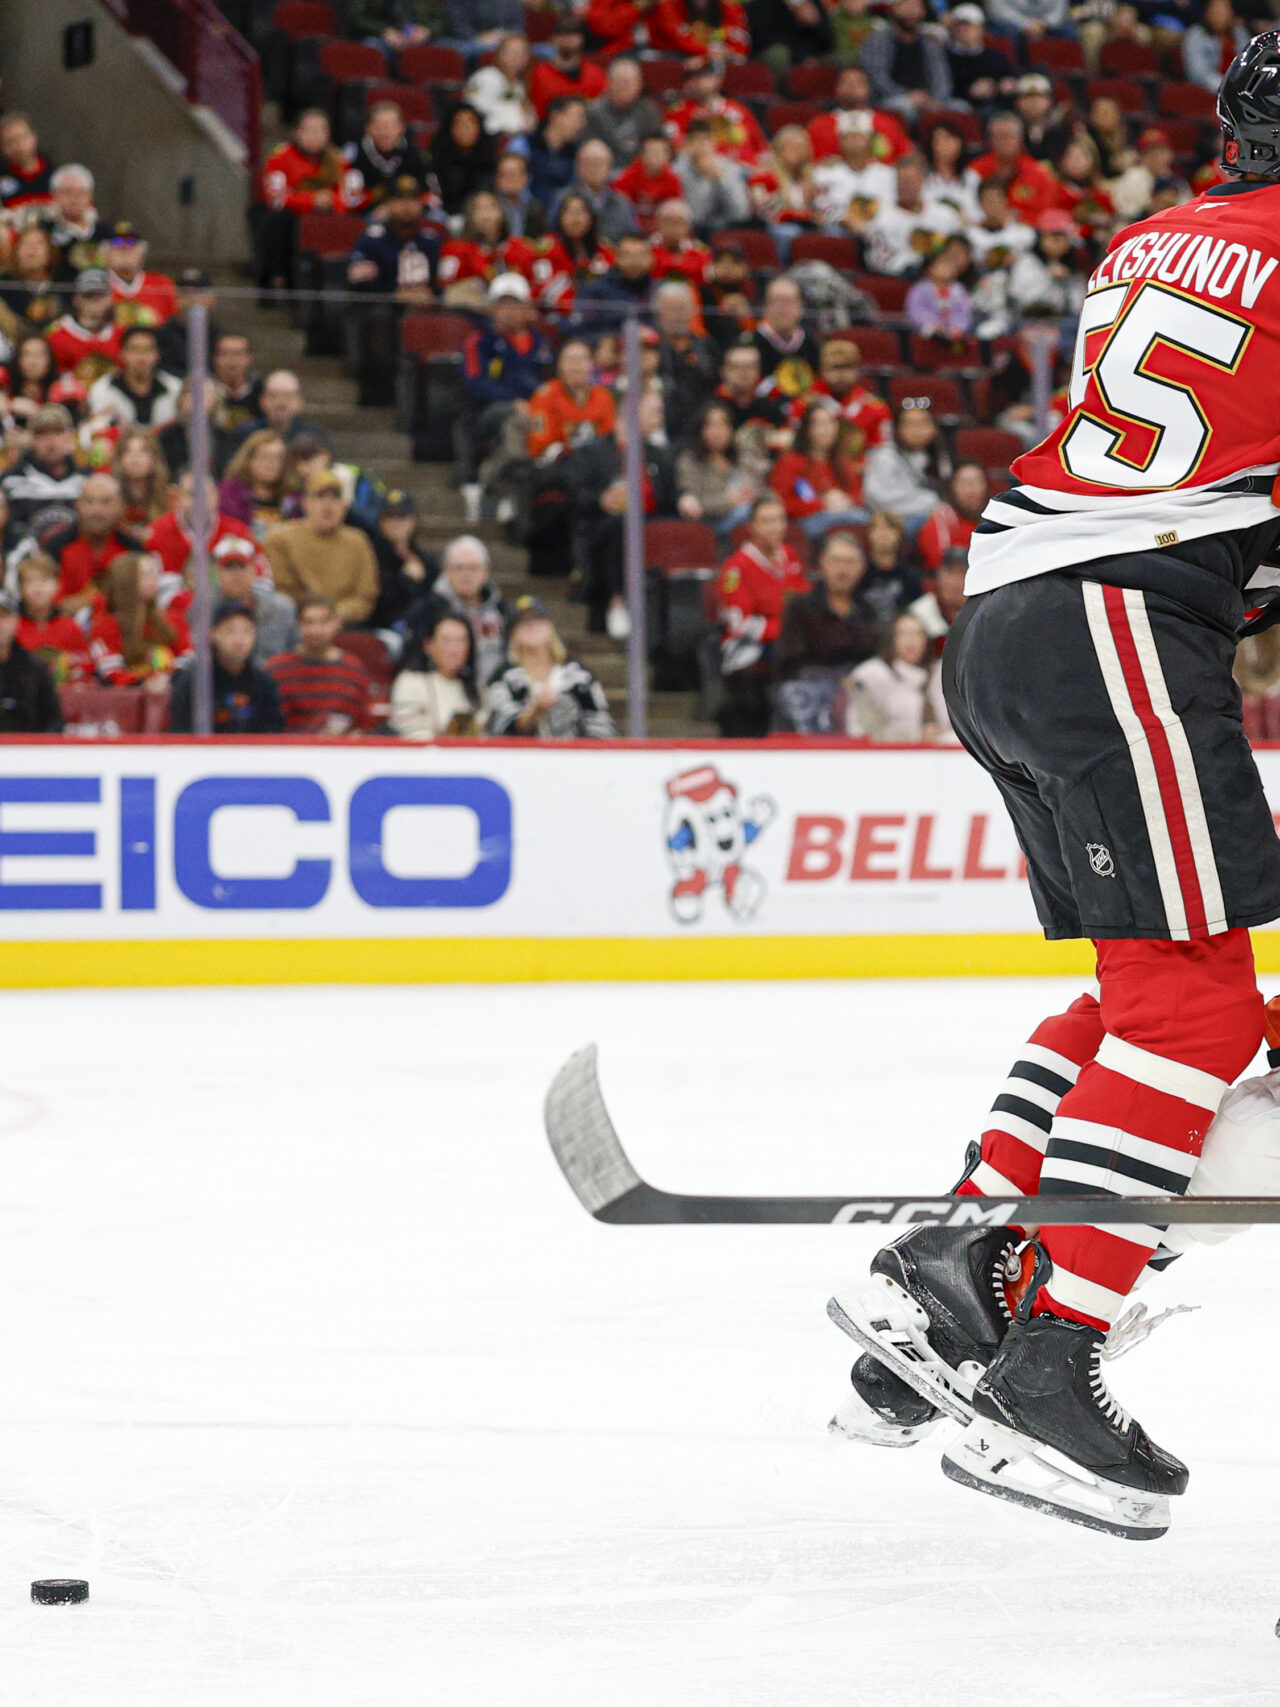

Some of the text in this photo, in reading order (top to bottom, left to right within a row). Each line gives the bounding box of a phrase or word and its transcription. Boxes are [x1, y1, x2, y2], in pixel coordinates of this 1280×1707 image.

[1058, 278, 1256, 490] 55
[1157, 532, 1176, 545] 100
[0, 776, 513, 911] EICO
[785, 814, 1028, 881] BELL
[831, 1202, 1018, 1226] CCM
